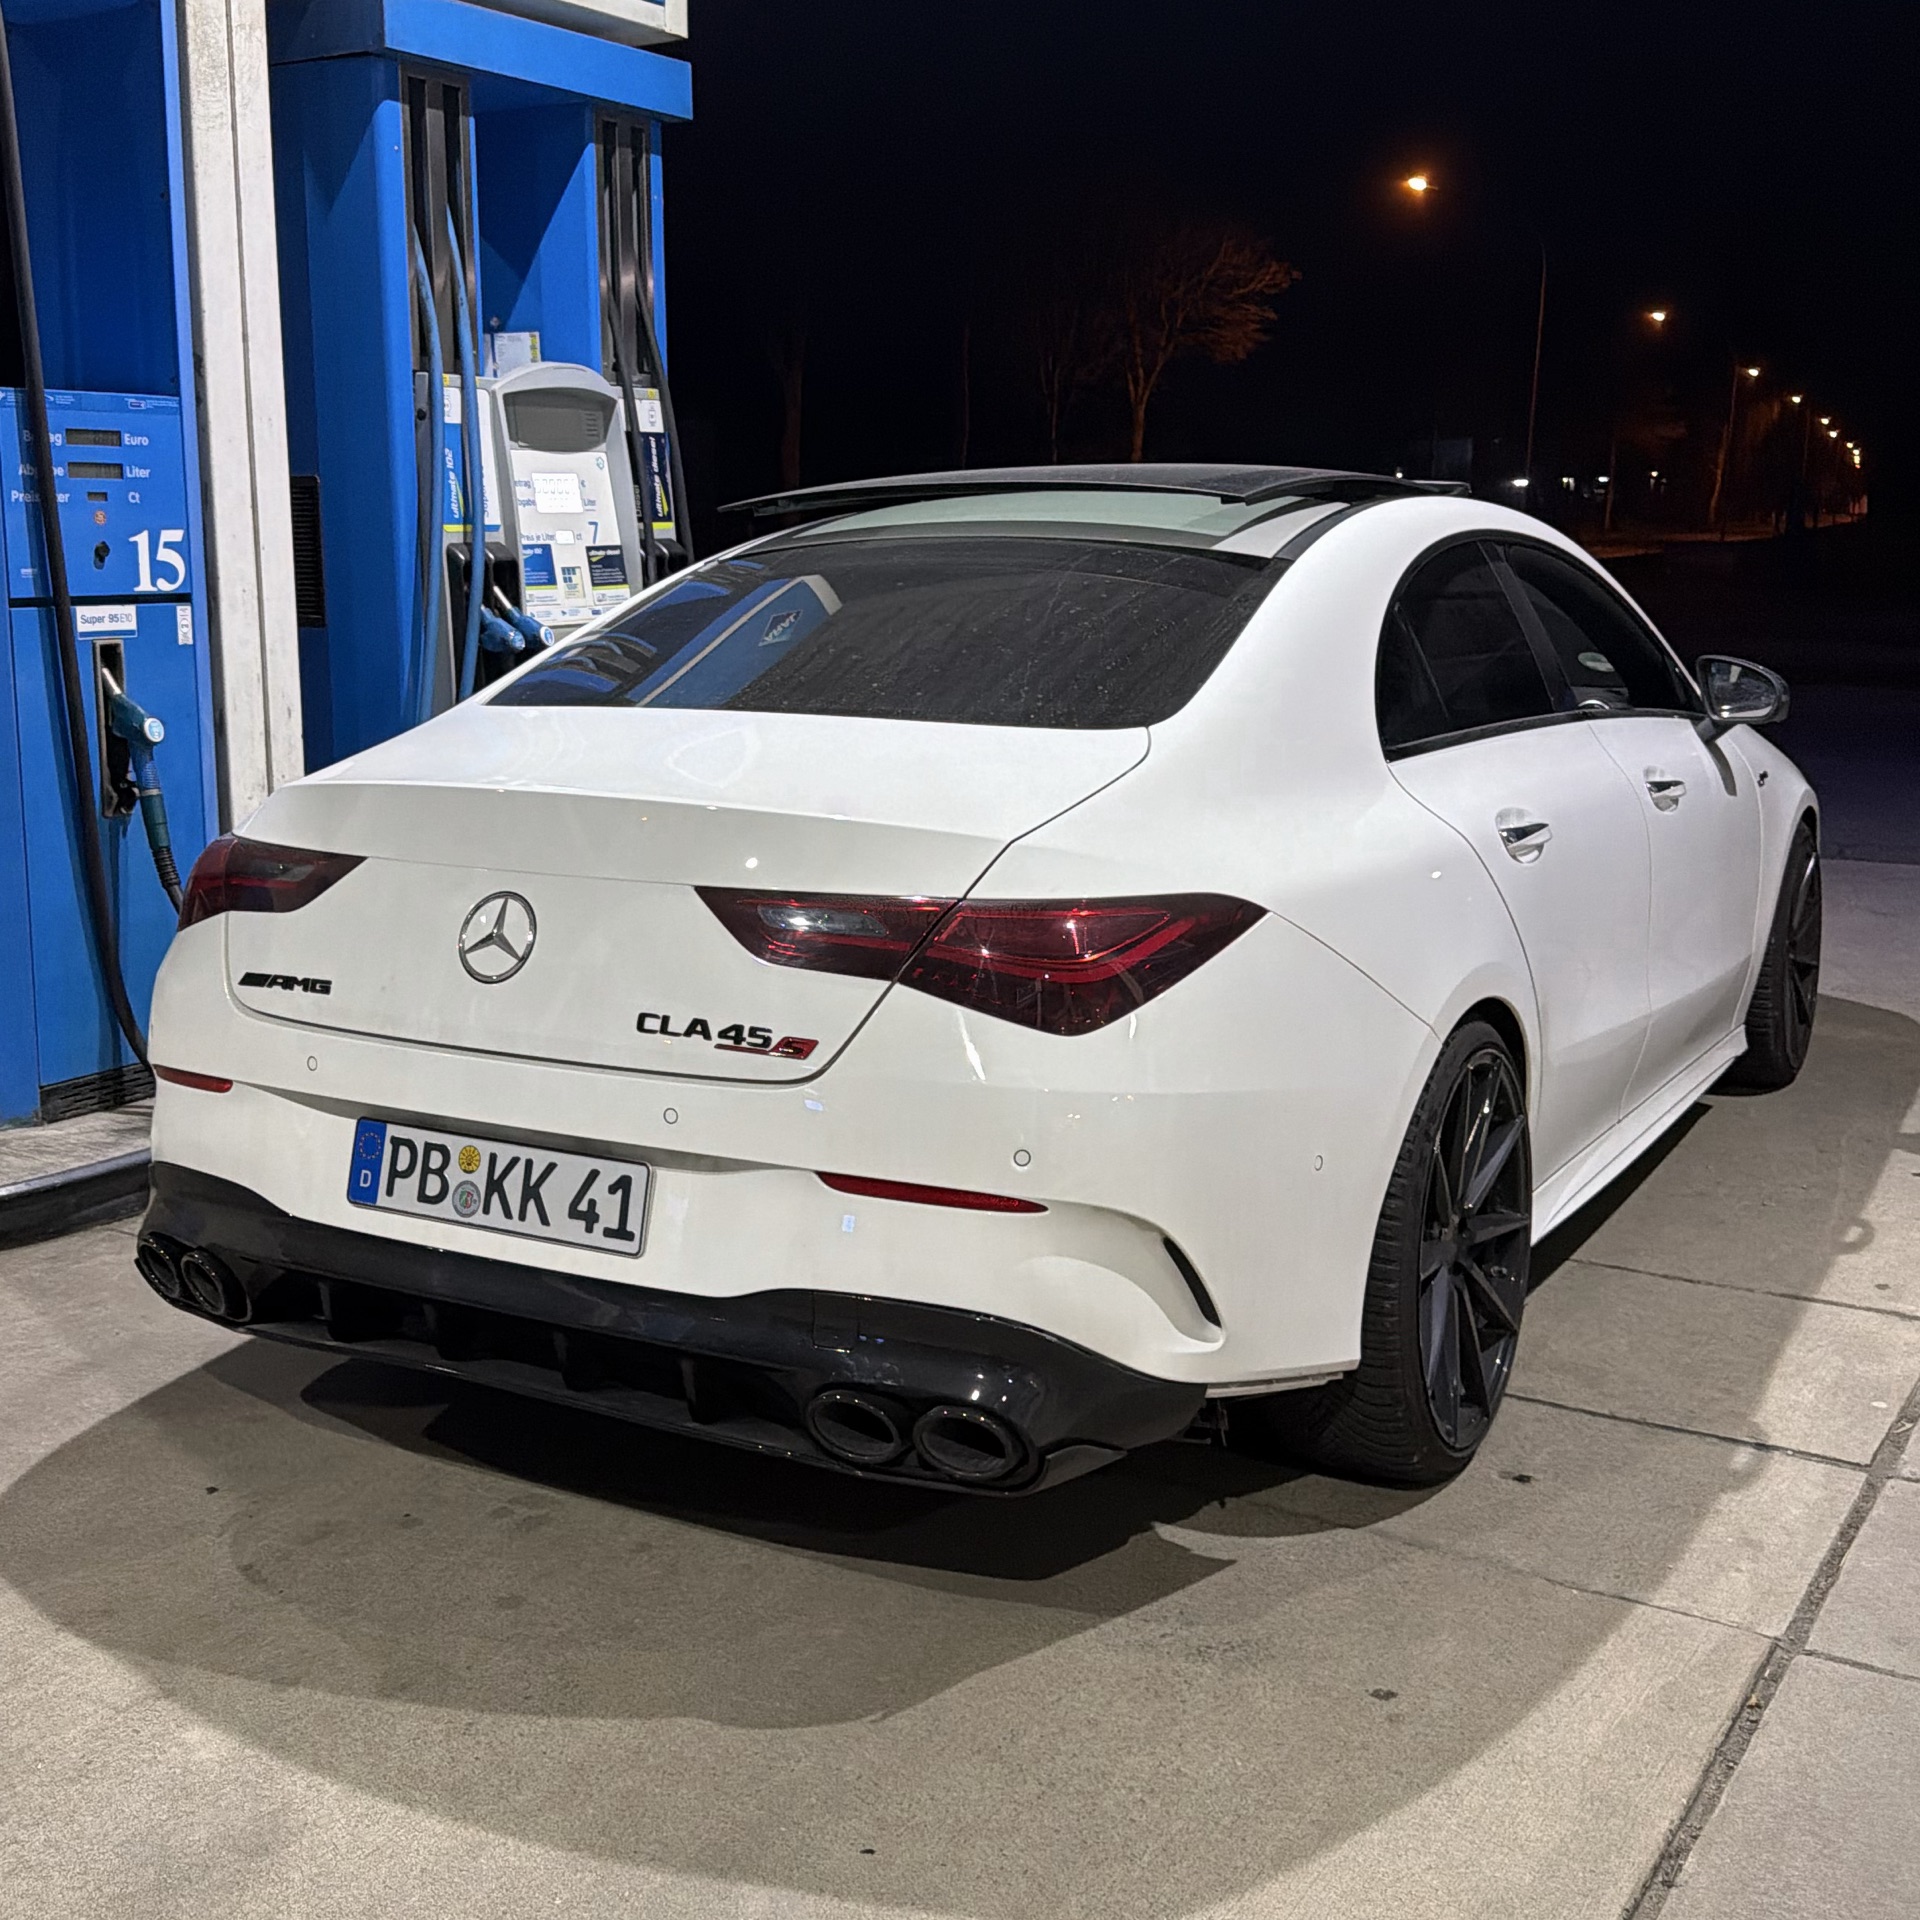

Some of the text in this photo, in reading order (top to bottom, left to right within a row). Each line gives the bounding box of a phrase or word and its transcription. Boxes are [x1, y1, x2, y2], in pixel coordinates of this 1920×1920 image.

[124, 433, 149, 446] Euro
[648, 436, 659, 473] diesel
[126, 466, 150, 478] Liter
[444, 447, 459, 519] ultimate 102
[129, 492, 140, 504] Ct
[654, 474, 664, 517] ultimate
[588, 521, 598, 544] 7
[129, 529, 186, 592] 15
[80, 614, 106, 627] Super
[264, 973, 332, 996] AMG
[636, 1012, 712, 1041] CLA
[717, 1023, 773, 1049] 45
[359, 1169, 372, 1188] D
[386, 1135, 635, 1242] PB KK 41
